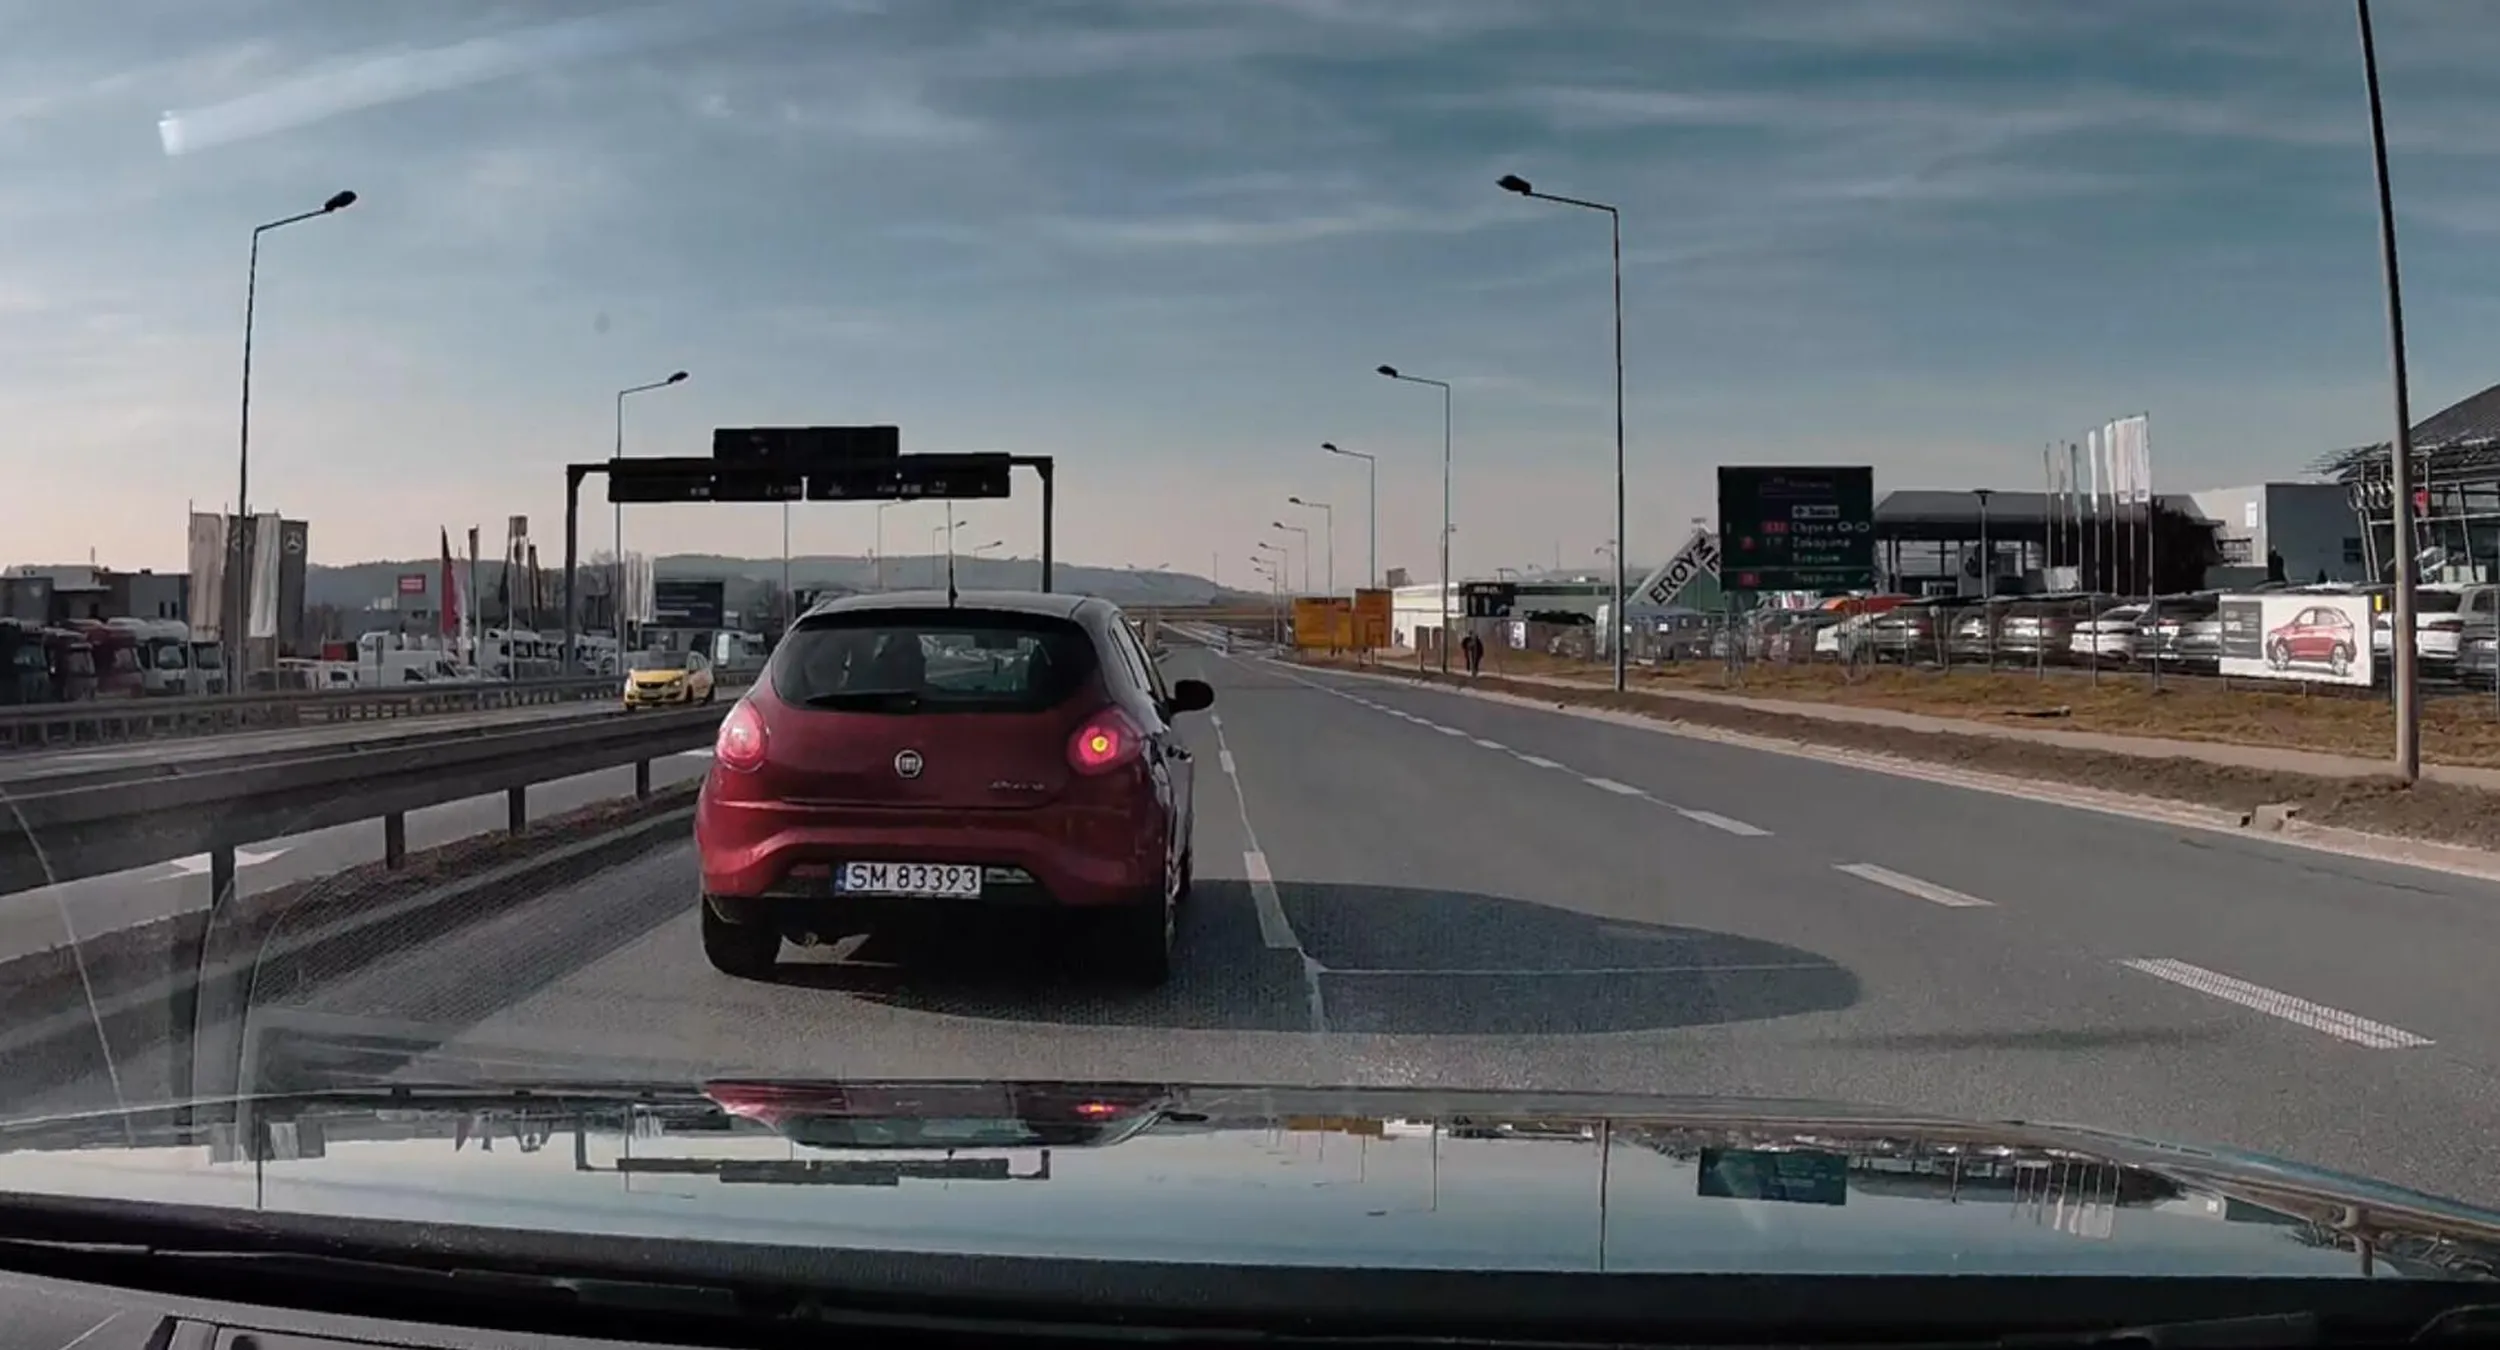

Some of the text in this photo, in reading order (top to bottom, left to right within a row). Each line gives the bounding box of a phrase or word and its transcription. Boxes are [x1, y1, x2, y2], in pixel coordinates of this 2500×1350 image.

[1692, 537, 1719, 573] ME
[1648, 552, 1697, 605] EROY
[851, 864, 977, 892] SM 83393
